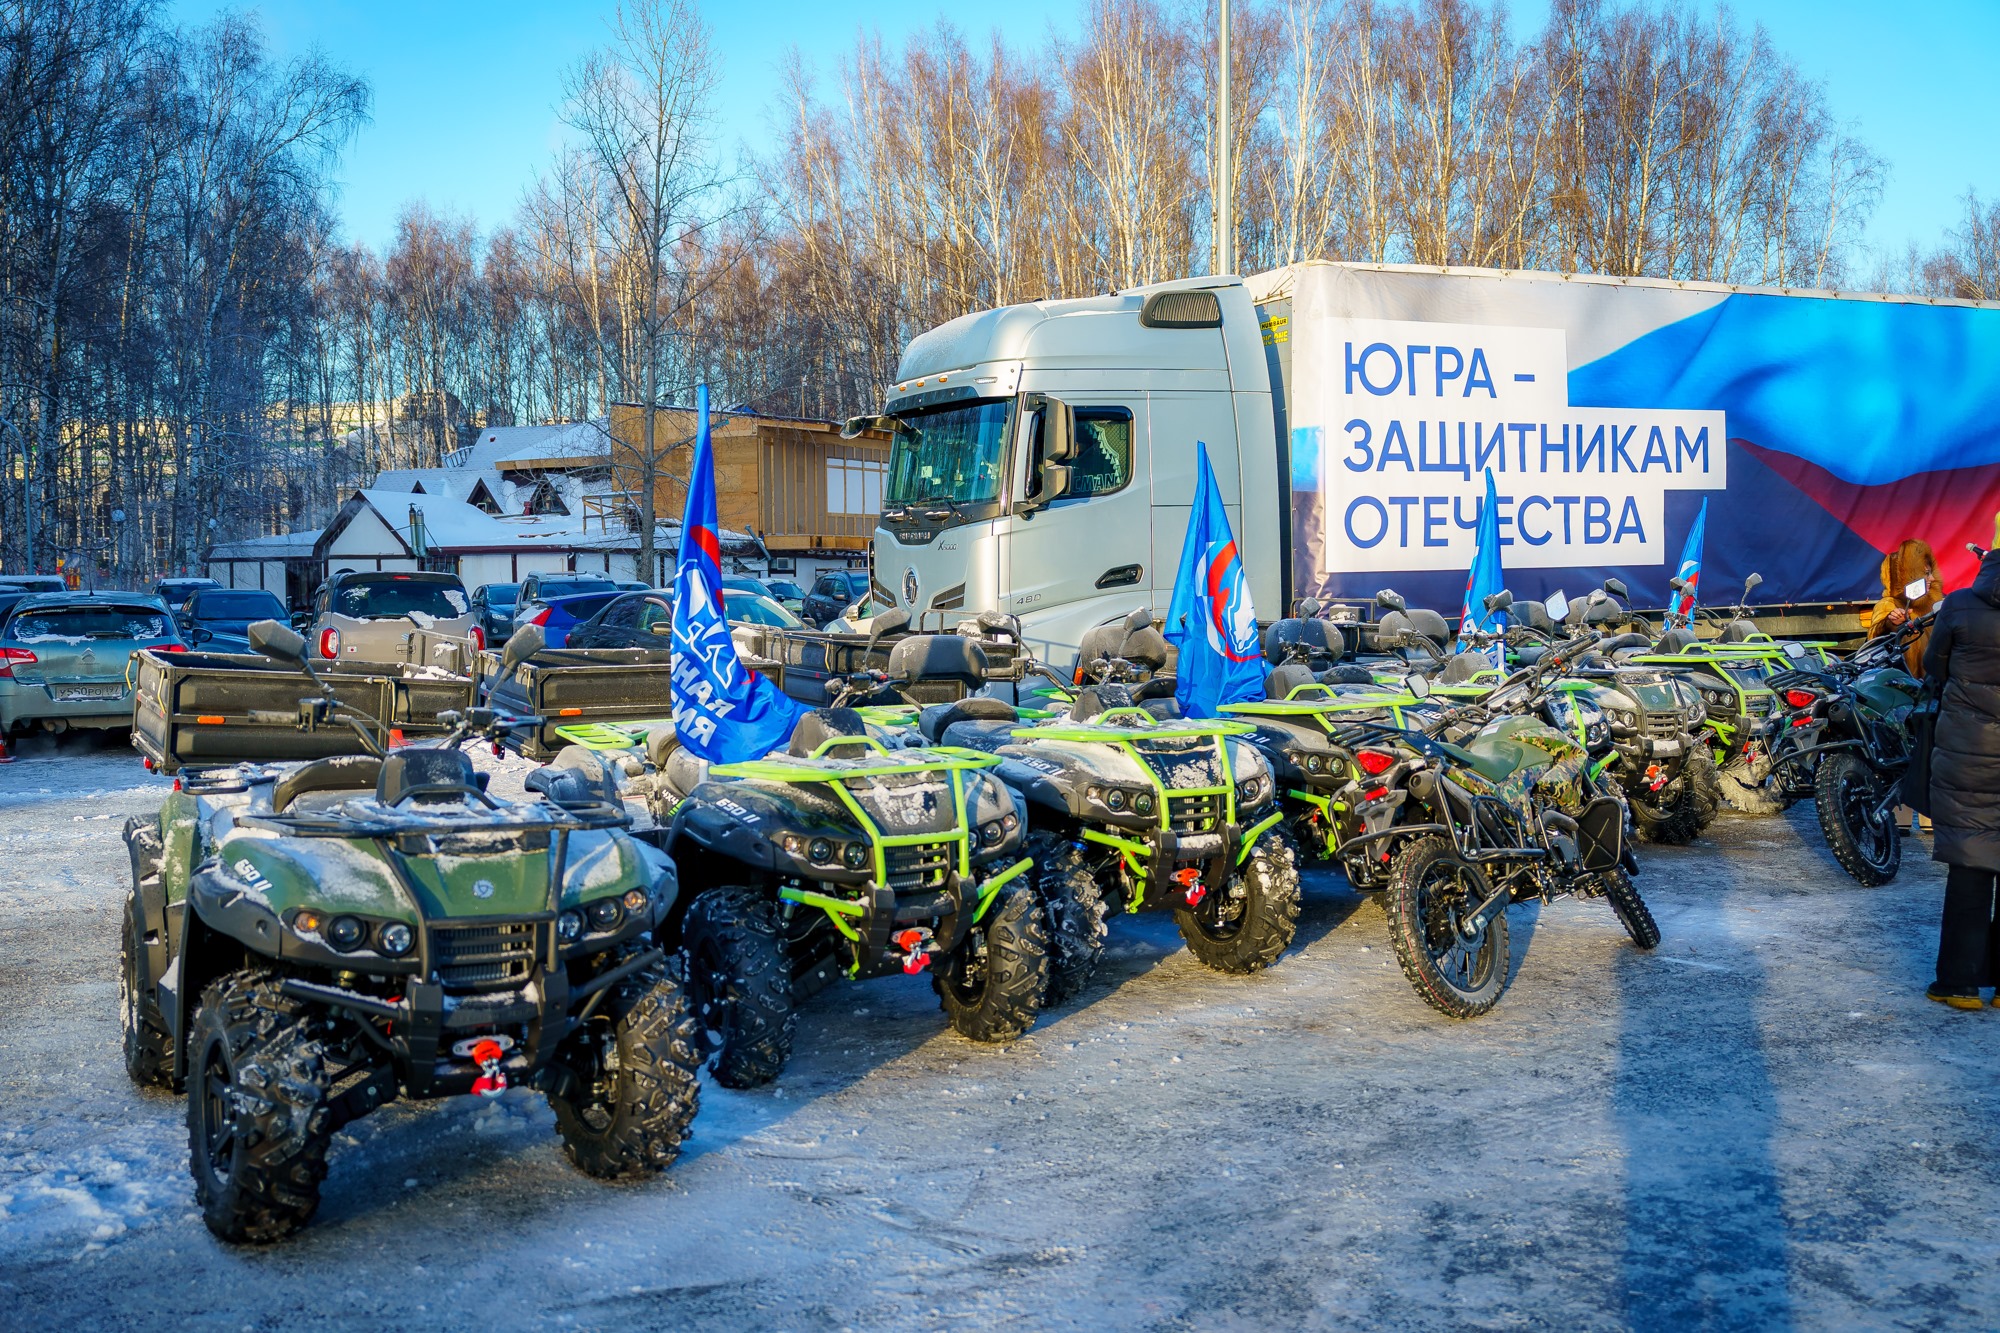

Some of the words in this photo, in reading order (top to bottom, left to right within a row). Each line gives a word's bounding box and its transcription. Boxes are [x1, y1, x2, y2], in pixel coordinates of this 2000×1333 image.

[1344, 341, 1497, 398] ЮГРА
[1343, 419, 1709, 482] ЗАЩИТНИКАМ
[1343, 495, 1647, 549] ОТЕЧЕСТВА
[1016, 593, 1042, 605] 480
[715, 798, 747, 816] 650
[234, 858, 261, 881] 650
